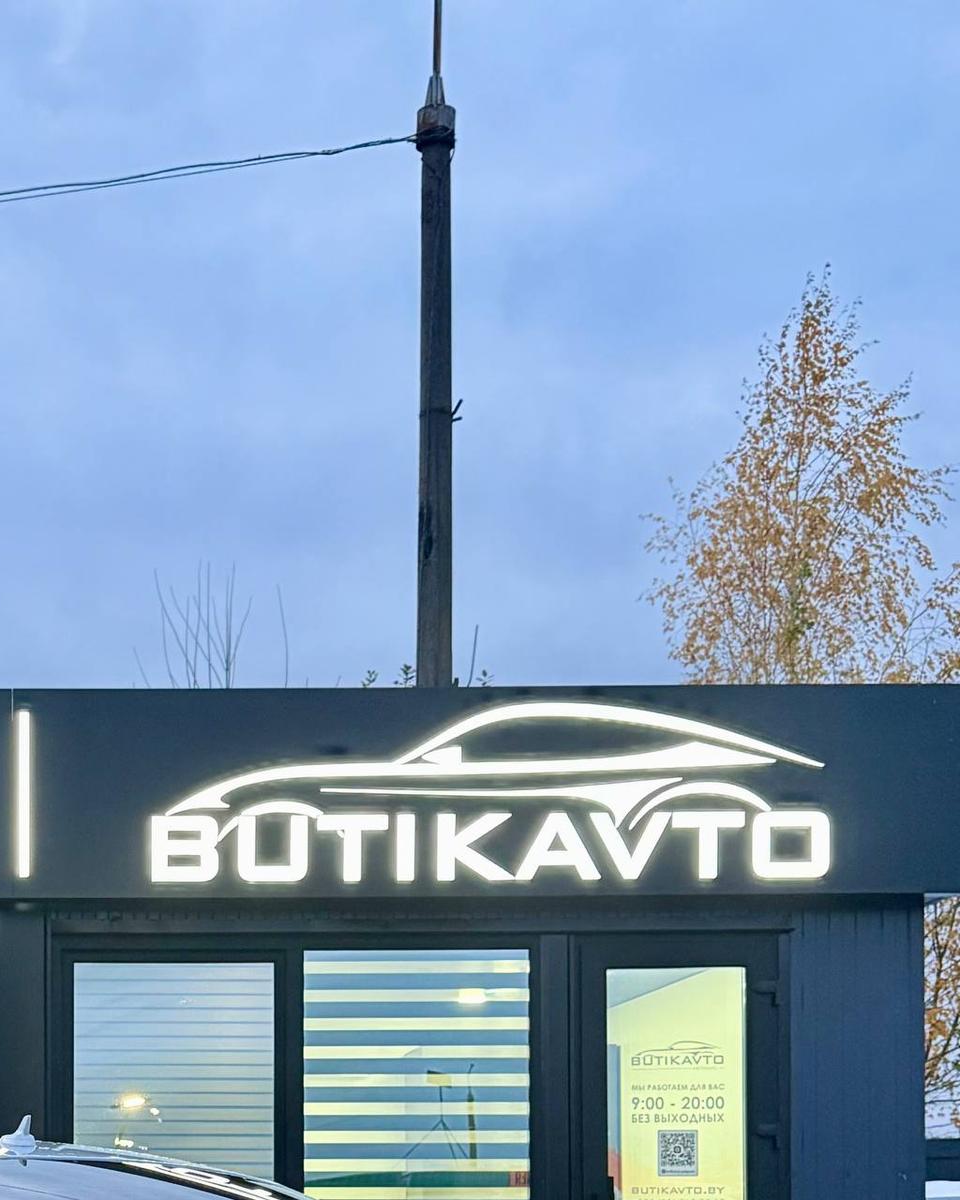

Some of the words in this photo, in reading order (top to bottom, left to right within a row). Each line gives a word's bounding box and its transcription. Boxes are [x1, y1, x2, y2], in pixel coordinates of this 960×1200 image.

[150, 810, 831, 883] BUTIKAVTO
[631, 1055, 724, 1066] BUTIKAVTO
[631, 1097, 664, 1110] 9:00
[681, 1096, 725, 1110] 20:00
[631, 1113, 650, 1123] БЕЗ
[654, 1113, 725, 1124] ВЫХОДНЫХ
[631, 1186, 725, 1195] BUTIKAVTO.BY
